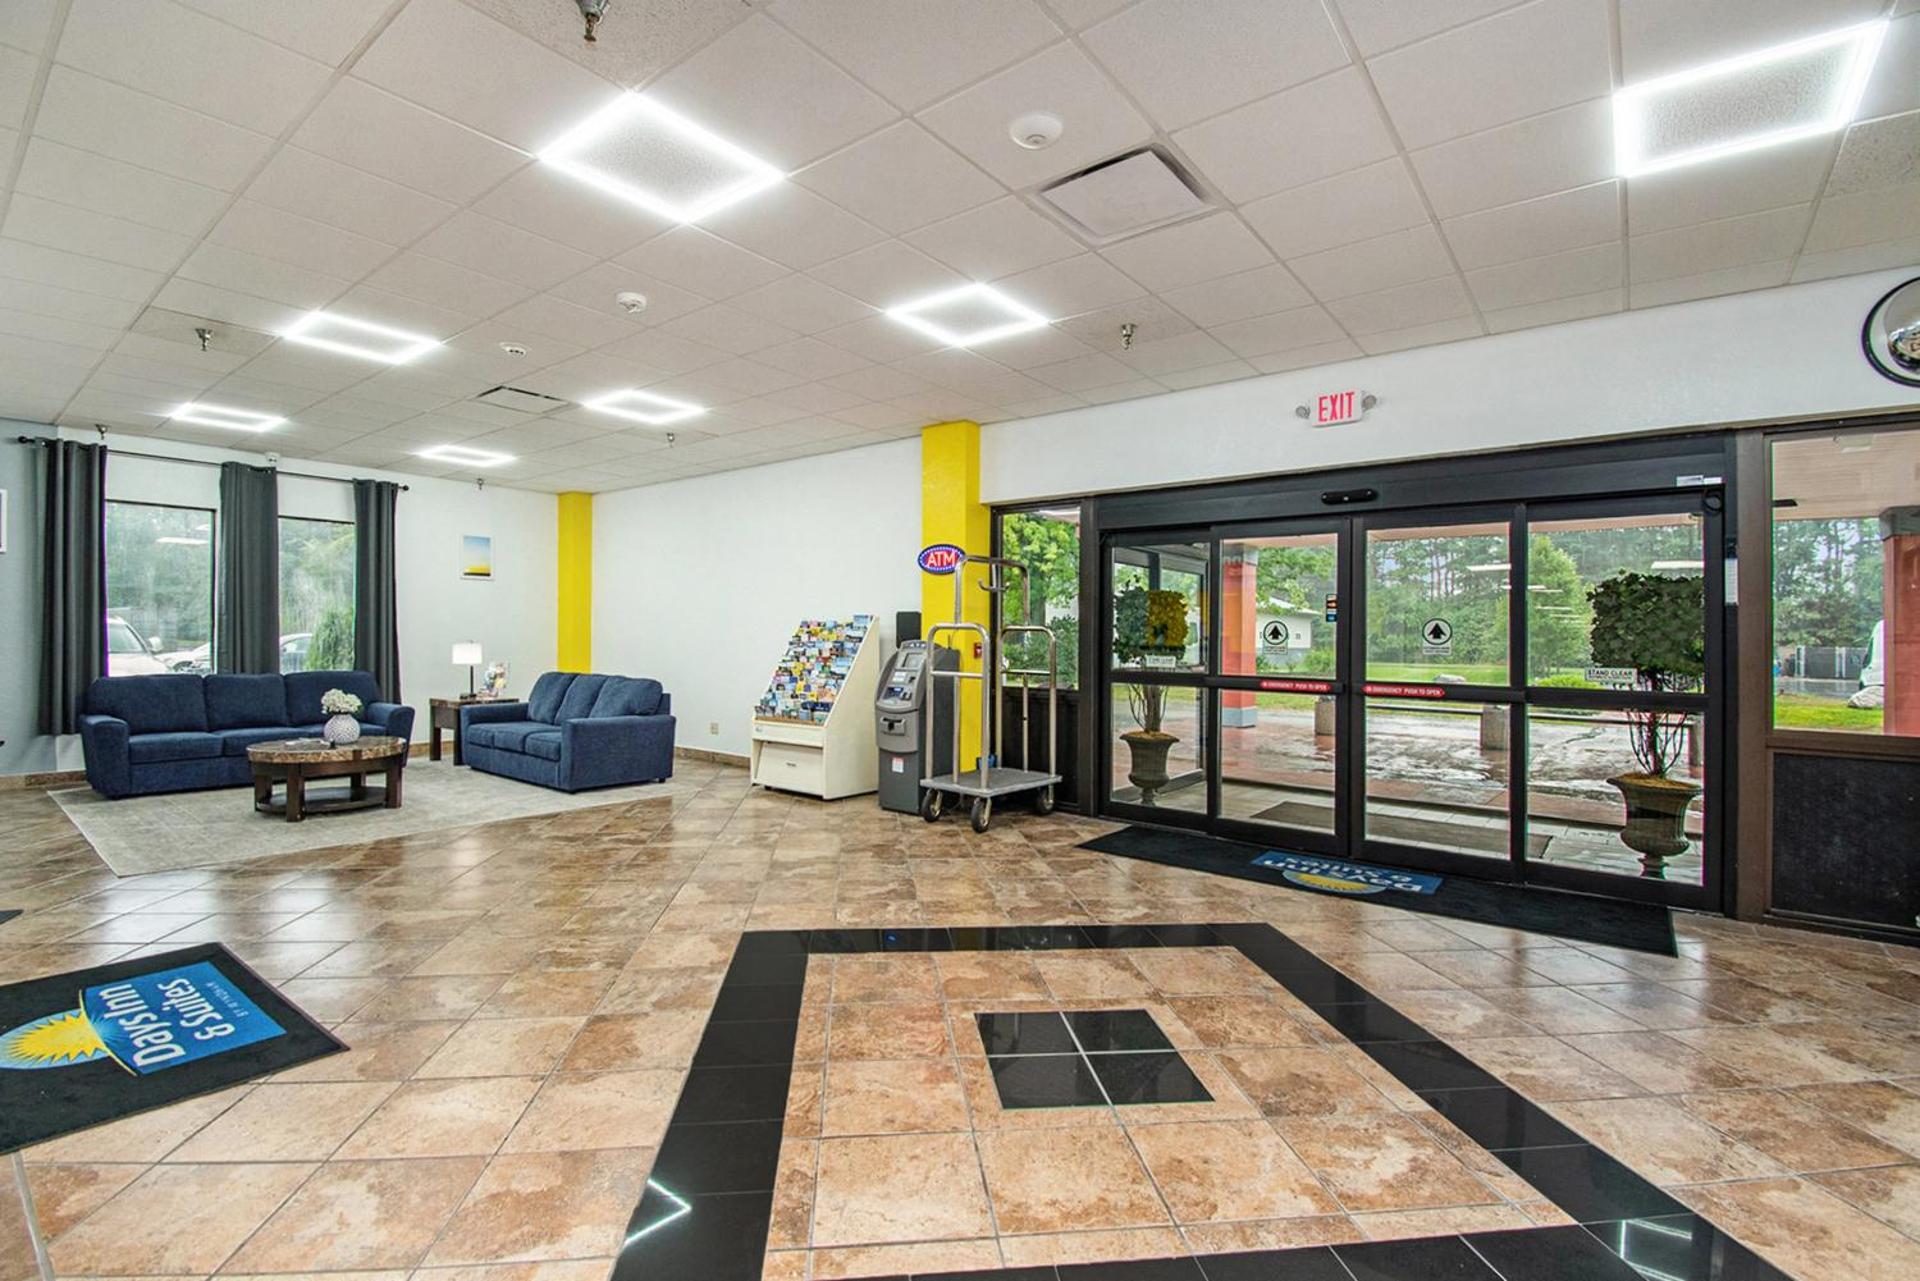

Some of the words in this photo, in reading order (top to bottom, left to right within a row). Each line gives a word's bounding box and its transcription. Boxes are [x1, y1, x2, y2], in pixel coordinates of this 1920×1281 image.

[1318, 391, 1355, 422] EXIT
[927, 550, 956, 567] ATM
[1403, 687, 1418, 695] PUSH
[1426, 688, 1440, 696] OPEN
[98, 984, 148, 1018] Inn
[157, 978, 227, 1028] Suites
[119, 1013, 187, 1067] Days
[194, 1023, 236, 1041] &
